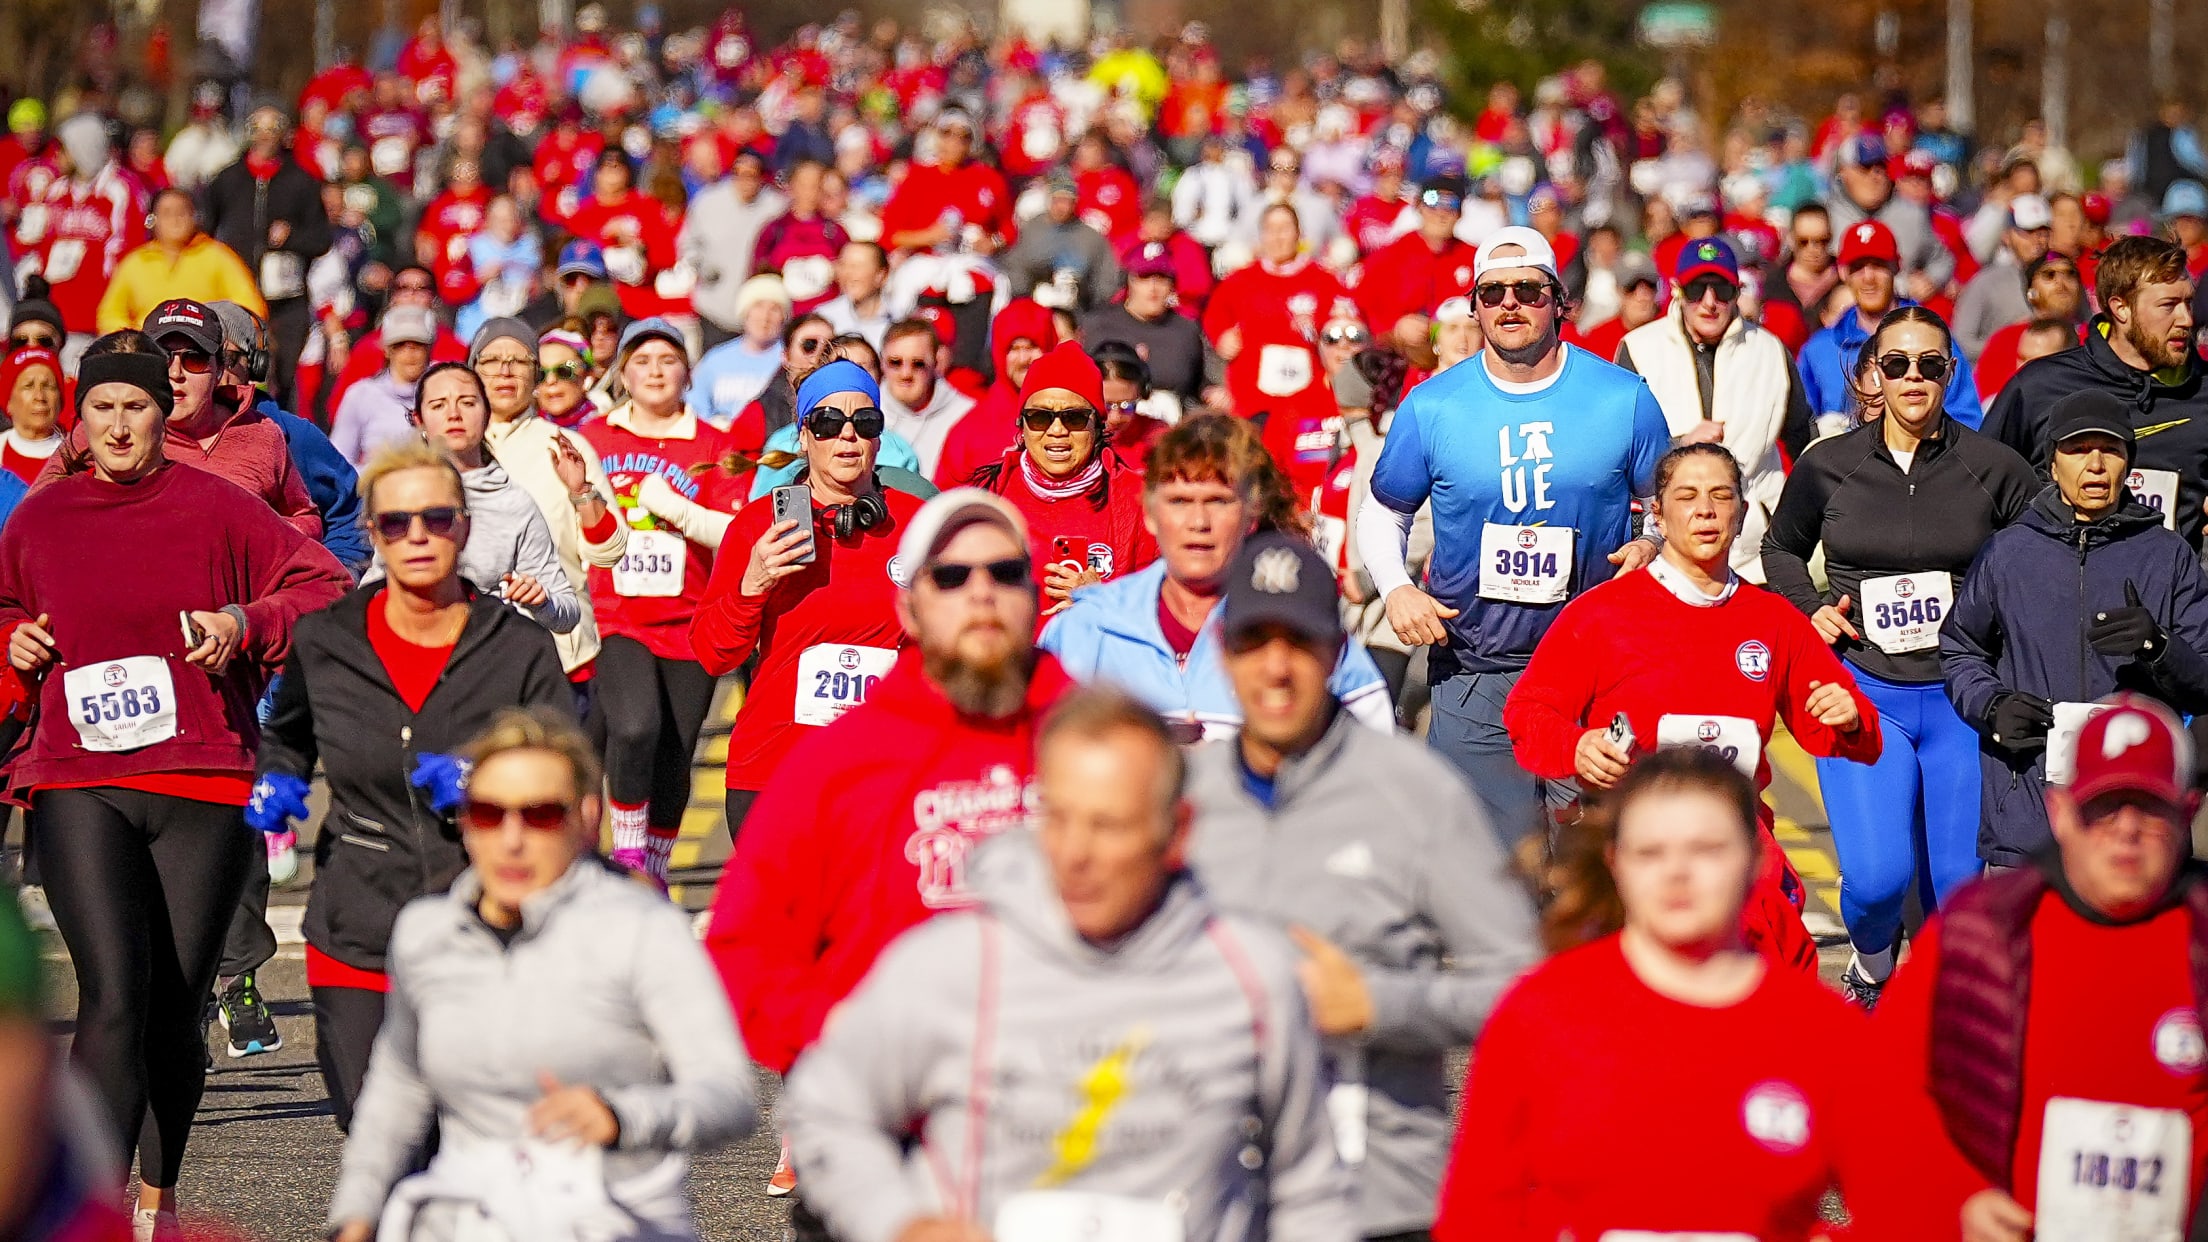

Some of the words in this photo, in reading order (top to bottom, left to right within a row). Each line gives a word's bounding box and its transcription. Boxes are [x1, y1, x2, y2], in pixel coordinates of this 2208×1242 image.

[1495, 549, 1558, 578] 3914
[1875, 596, 1941, 629] 3546
[80, 685, 160, 725] 5583
